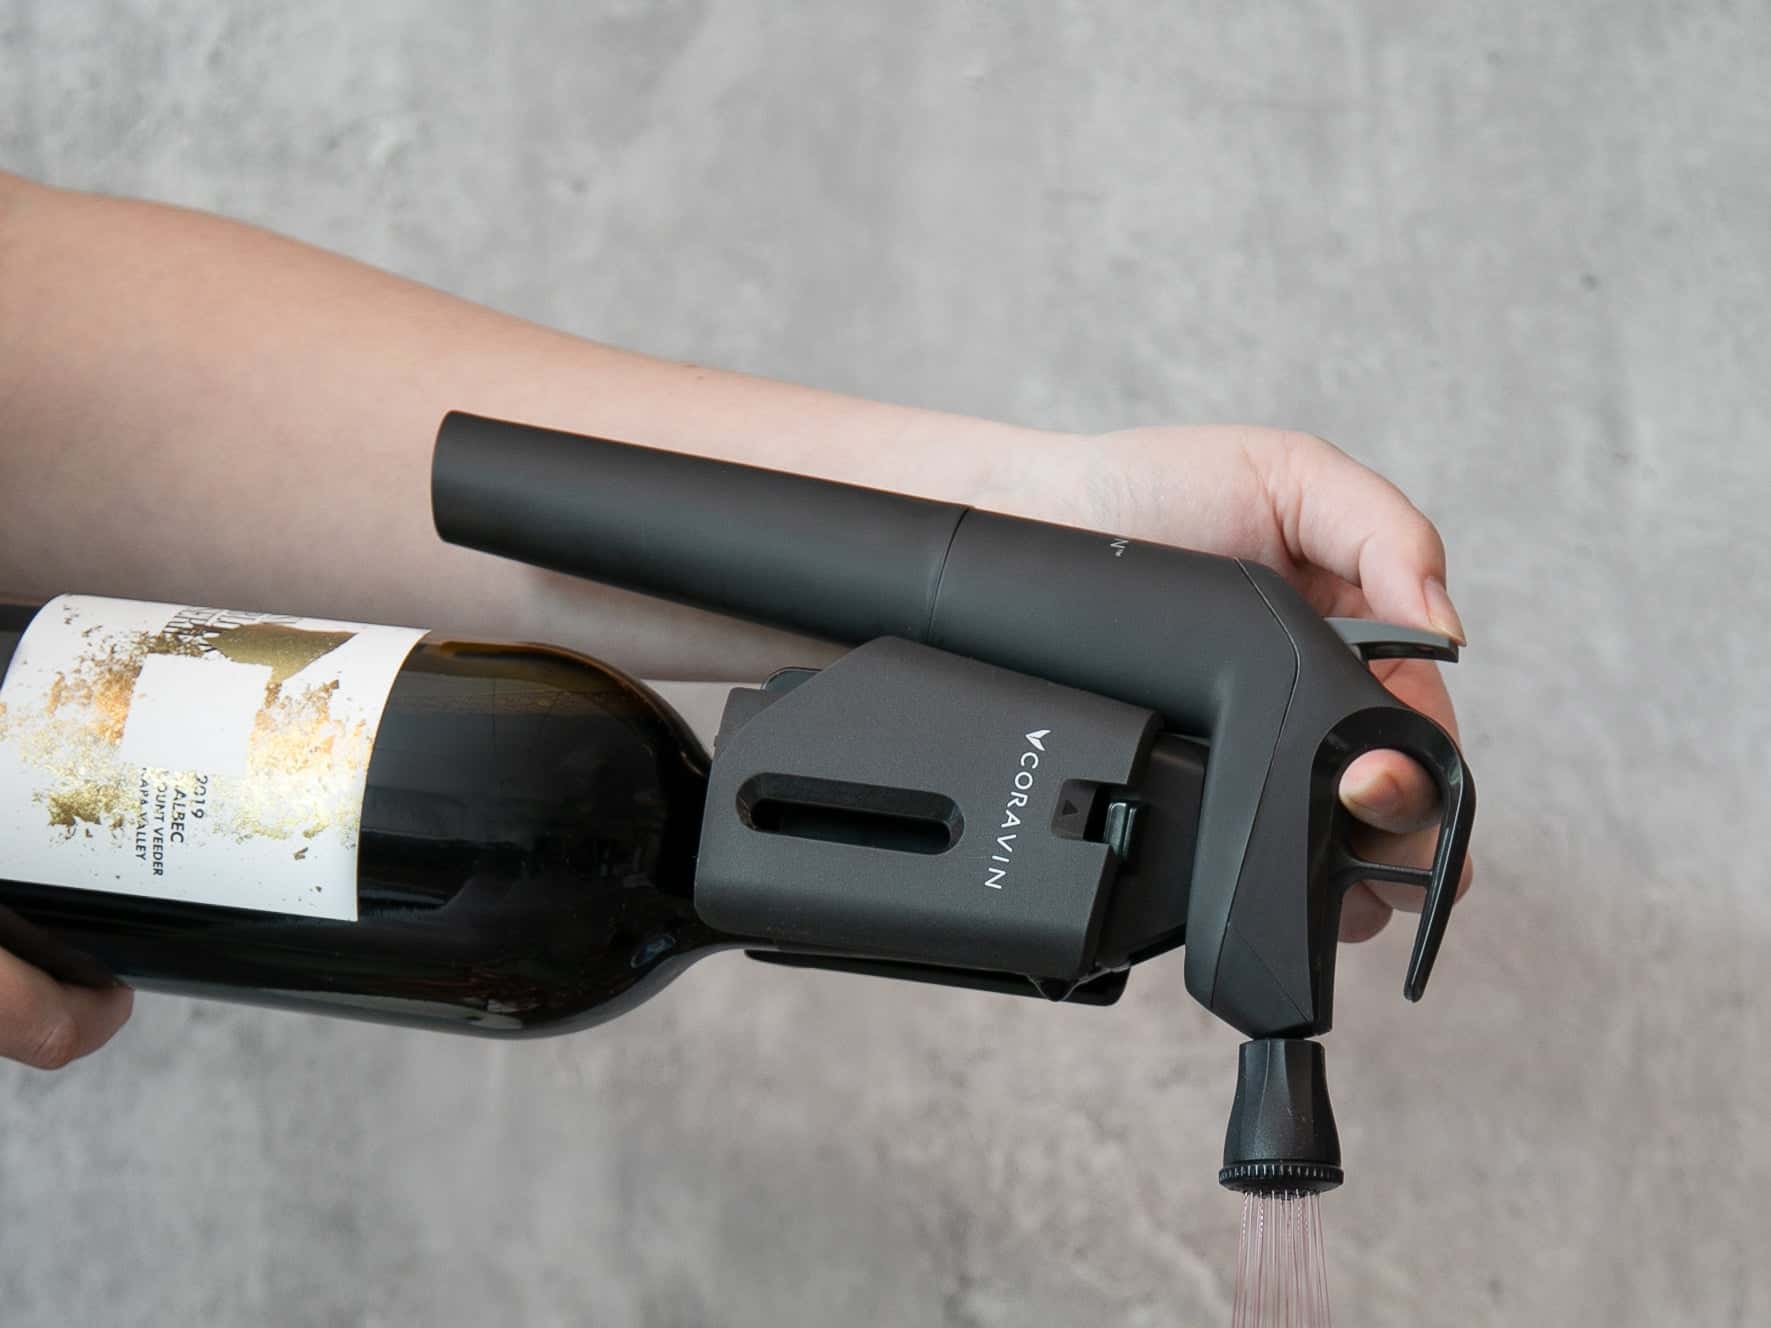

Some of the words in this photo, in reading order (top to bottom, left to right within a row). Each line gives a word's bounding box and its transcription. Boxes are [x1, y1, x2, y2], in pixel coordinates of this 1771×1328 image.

[154, 769, 168, 822] OUNT
[170, 771, 187, 843] ALBEC
[191, 775, 208, 819] 2019
[984, 751, 1039, 890] CORAVIN
[152, 827, 164, 876] VEEDER
